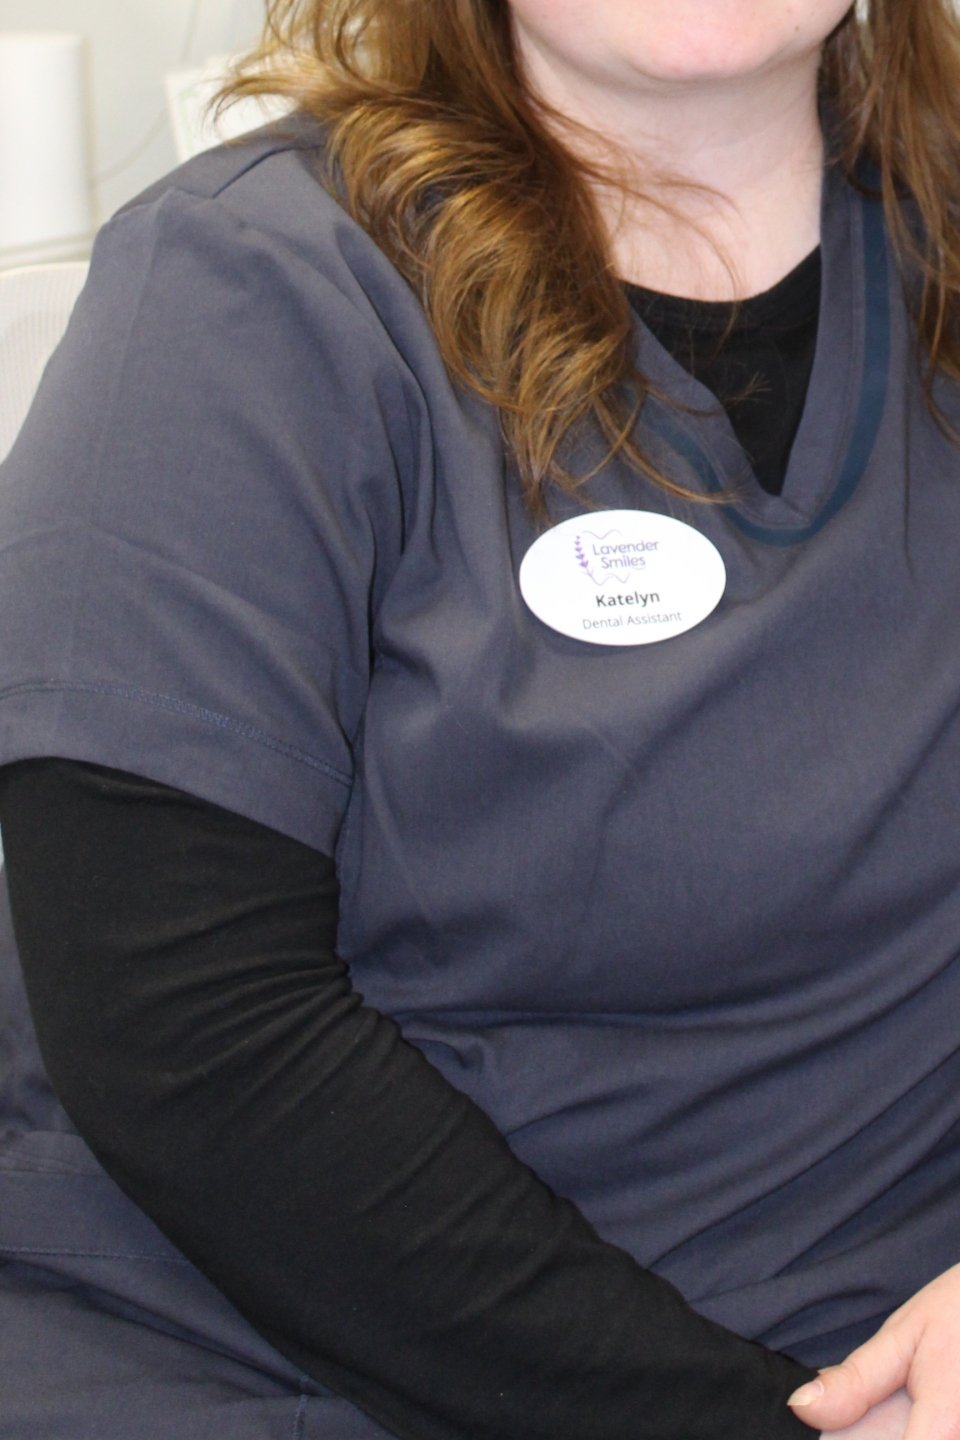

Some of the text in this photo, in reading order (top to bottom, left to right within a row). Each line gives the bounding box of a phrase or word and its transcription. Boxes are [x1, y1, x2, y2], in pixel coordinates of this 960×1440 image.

[592, 540, 660, 556] Lavender
[600, 555, 647, 569] Smiles
[595, 591, 661, 608] Katelyn
[582, 611, 683, 630] Dental Assistant
